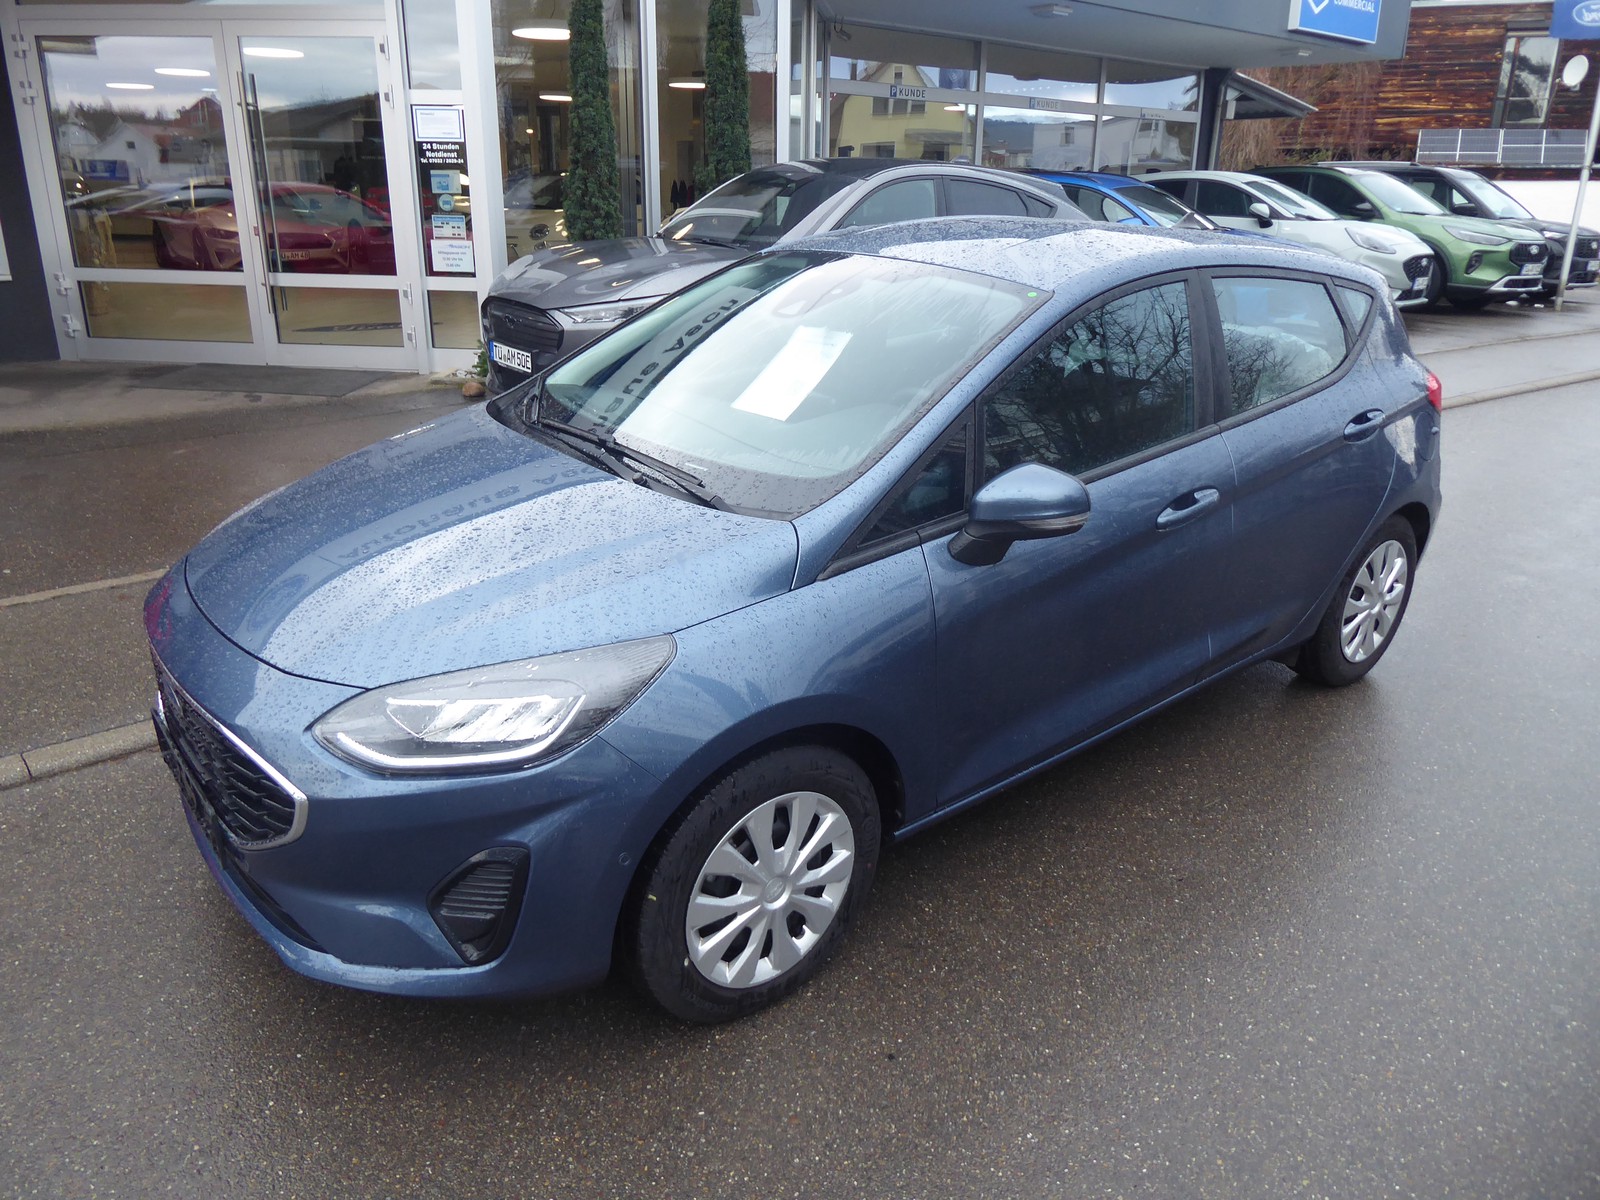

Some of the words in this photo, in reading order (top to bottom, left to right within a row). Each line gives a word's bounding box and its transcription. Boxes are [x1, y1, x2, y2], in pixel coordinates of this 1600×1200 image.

[898, 87, 926, 99] KUNDE
[1036, 99, 1059, 109] KUNDE
[494, 344, 502, 360] TÜ
[506, 349, 515, 365] AM
[517, 353, 530, 370] 50E
